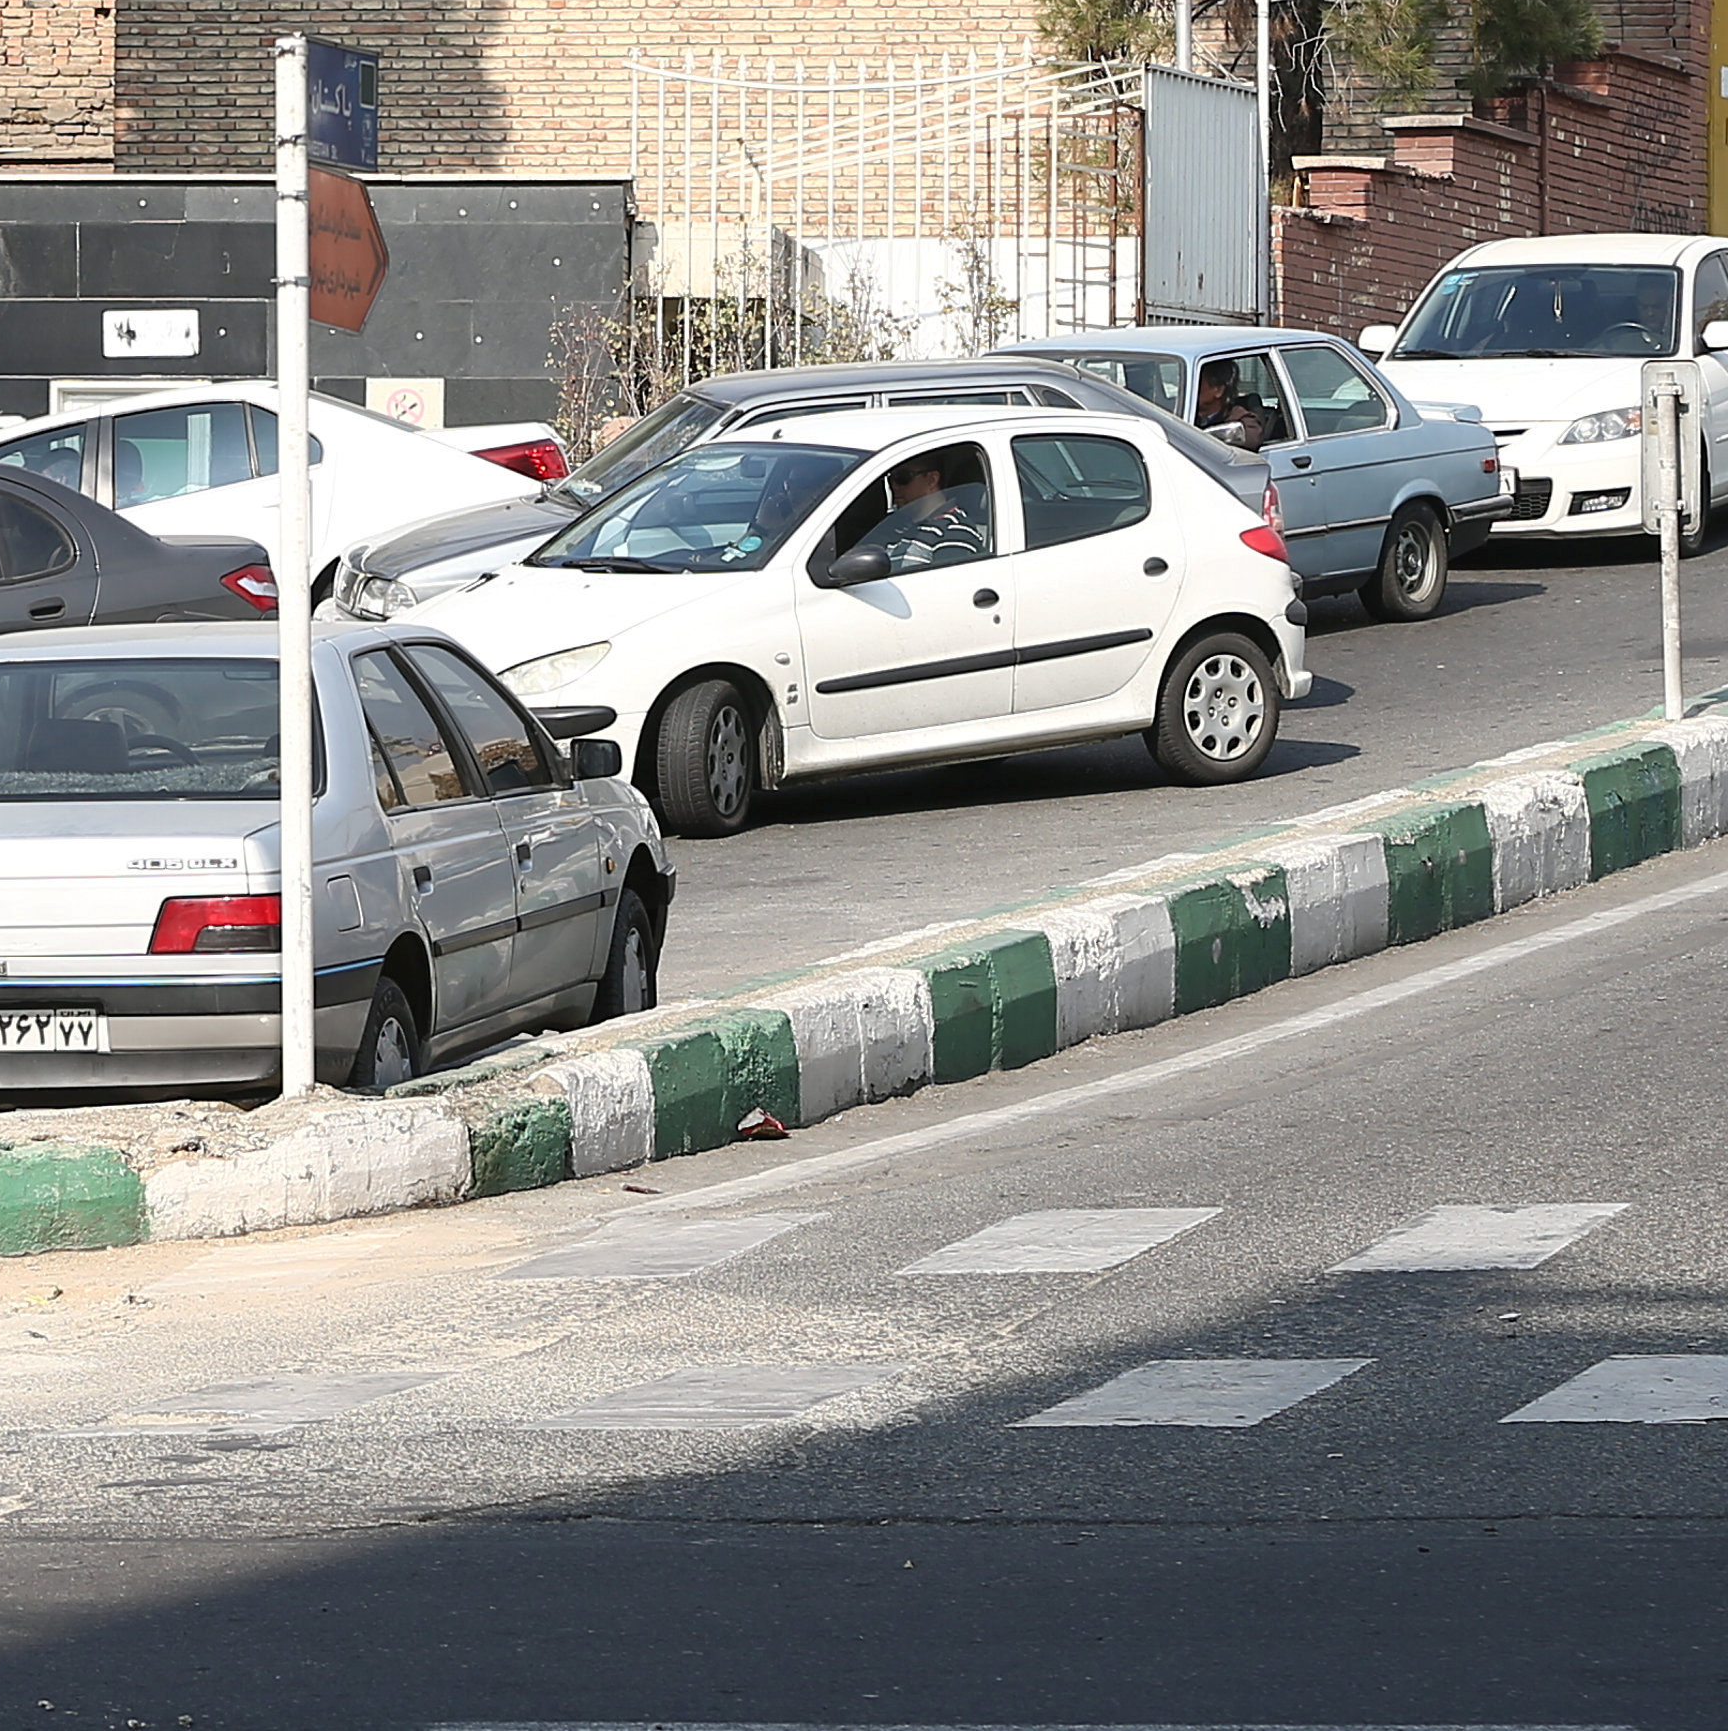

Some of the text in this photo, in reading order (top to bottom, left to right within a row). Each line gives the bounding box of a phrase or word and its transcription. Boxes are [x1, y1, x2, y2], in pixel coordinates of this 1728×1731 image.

[312, 79, 352, 131] پاکستان
[127, 858, 183, 870] 405
[59, 1020, 93, 1047] ۷۷
